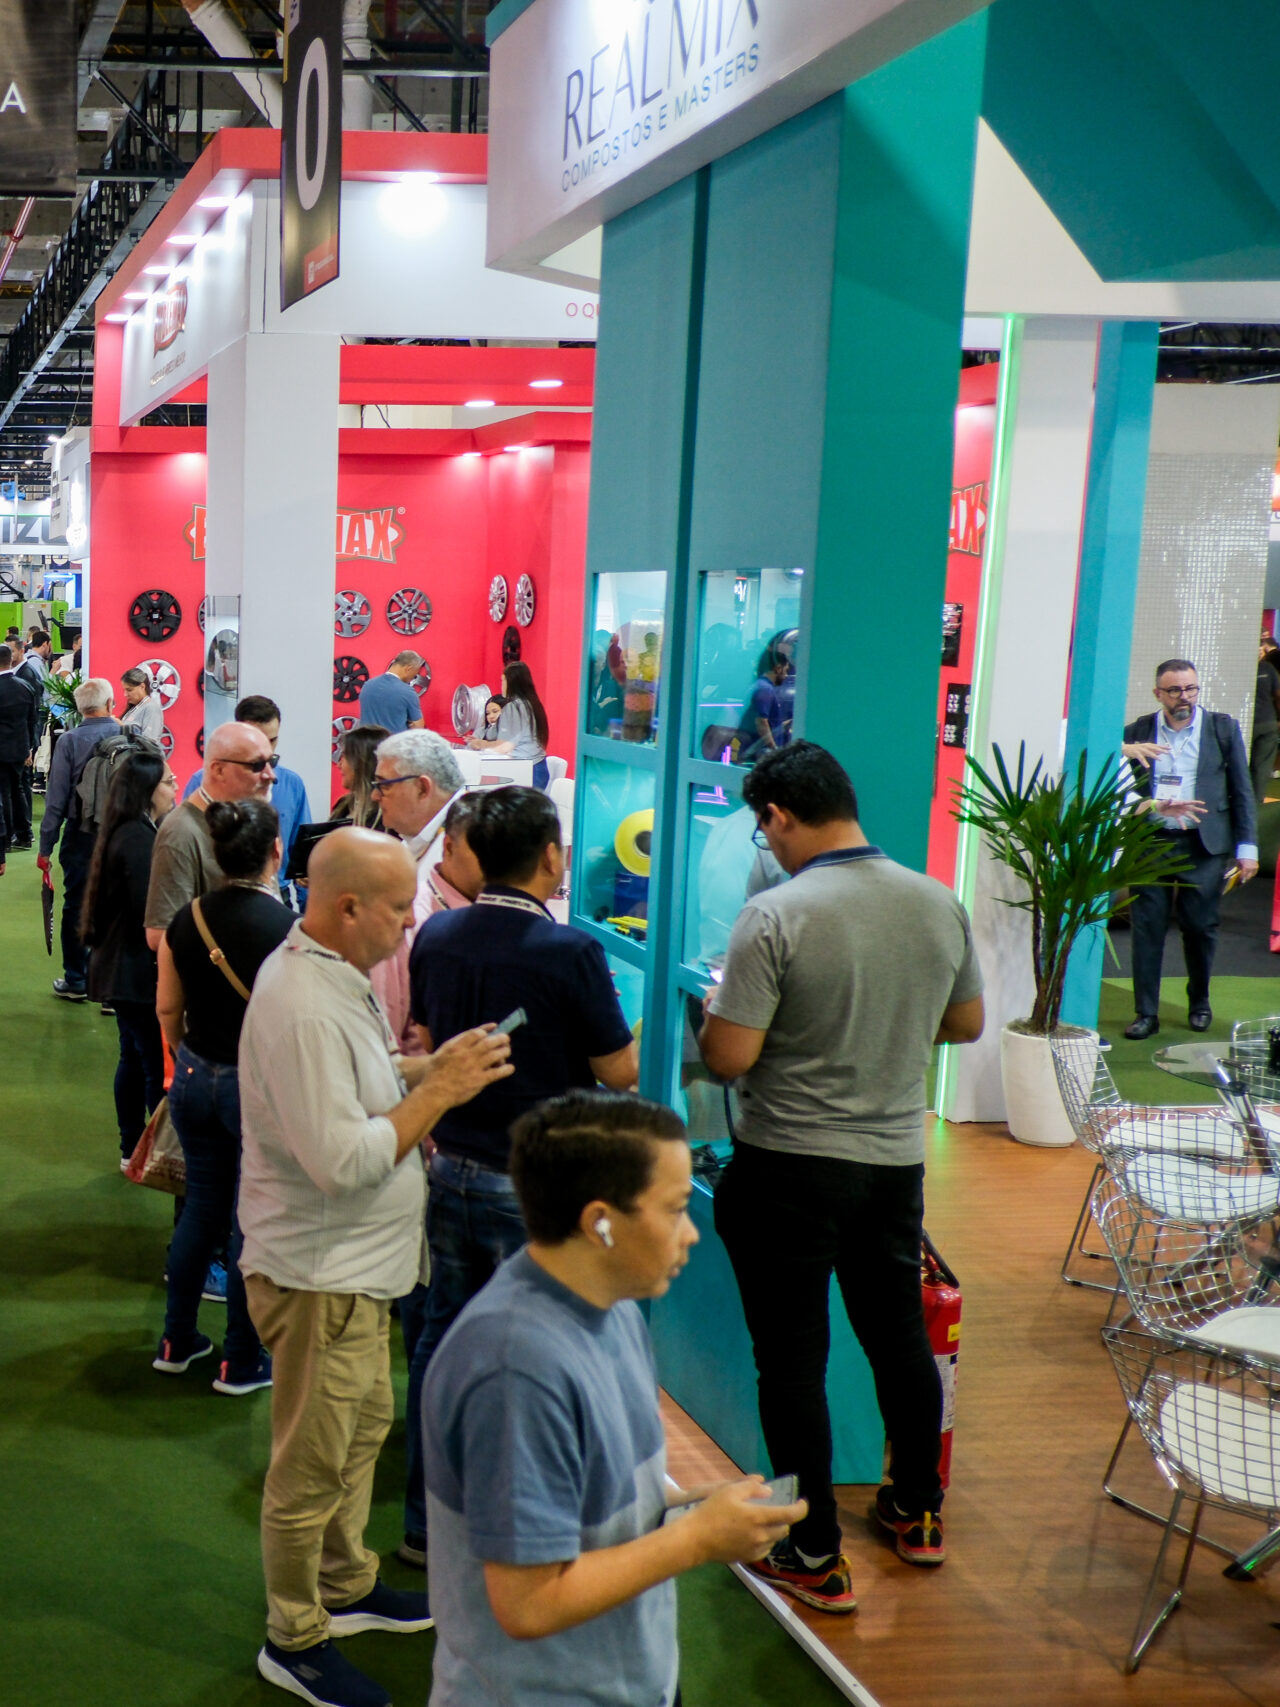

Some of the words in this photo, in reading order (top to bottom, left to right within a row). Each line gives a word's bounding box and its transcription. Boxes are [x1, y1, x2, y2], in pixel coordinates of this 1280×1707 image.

[561, 115, 652, 192] COMPOSTOS
[658, 104, 667, 131] E
[674, 43, 759, 120] MASTERS
